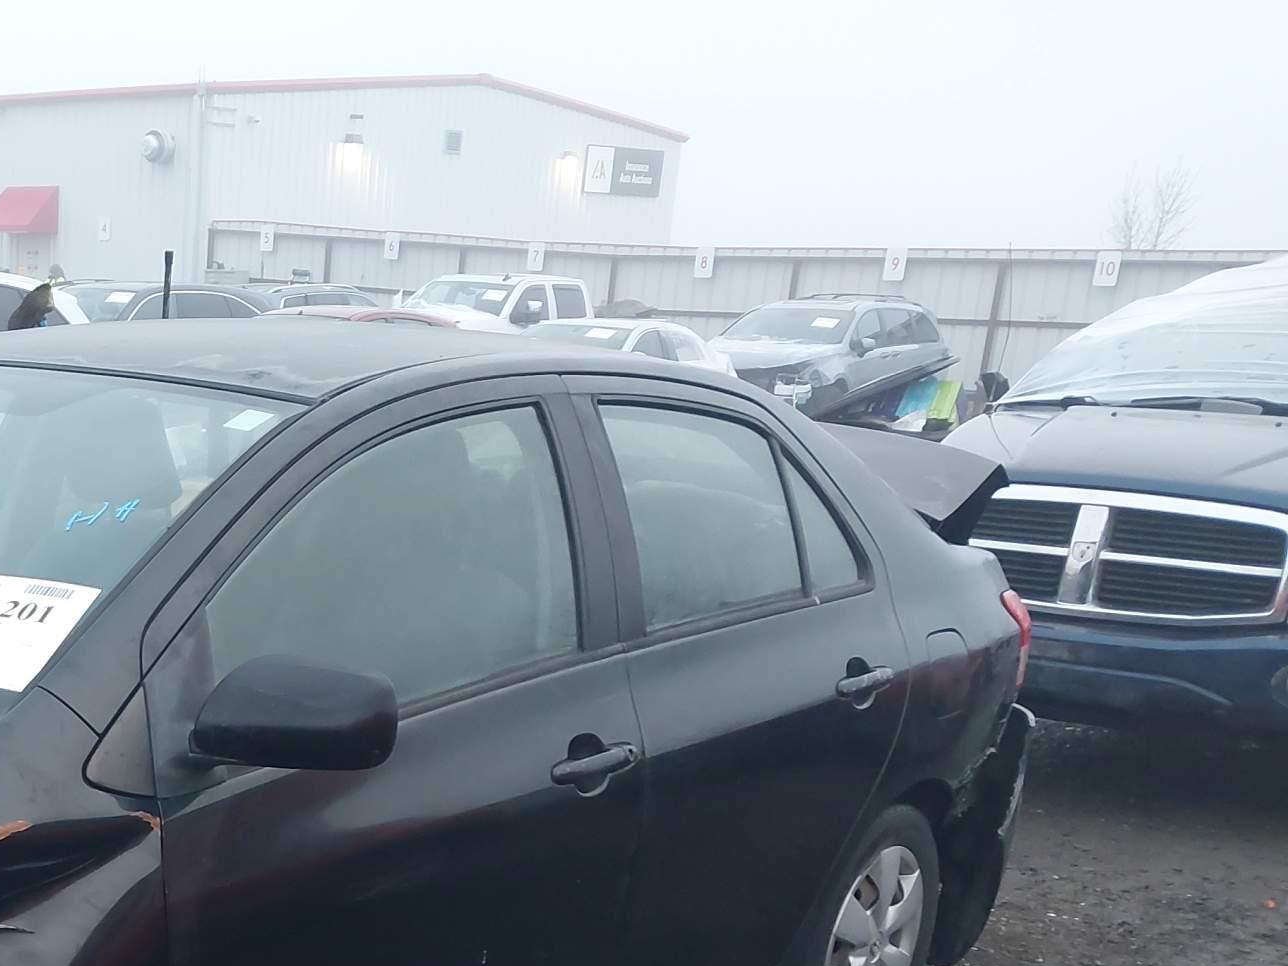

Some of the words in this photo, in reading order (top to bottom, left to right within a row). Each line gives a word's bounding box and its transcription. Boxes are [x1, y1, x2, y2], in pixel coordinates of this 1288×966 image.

[262, 235, 270, 245] 5
[388, 240, 396, 252] 6
[532, 249, 540, 263] 7
[700, 255, 709, 270] 8
[891, 256, 900, 271] 9
[1099, 261, 1116, 277] 10
